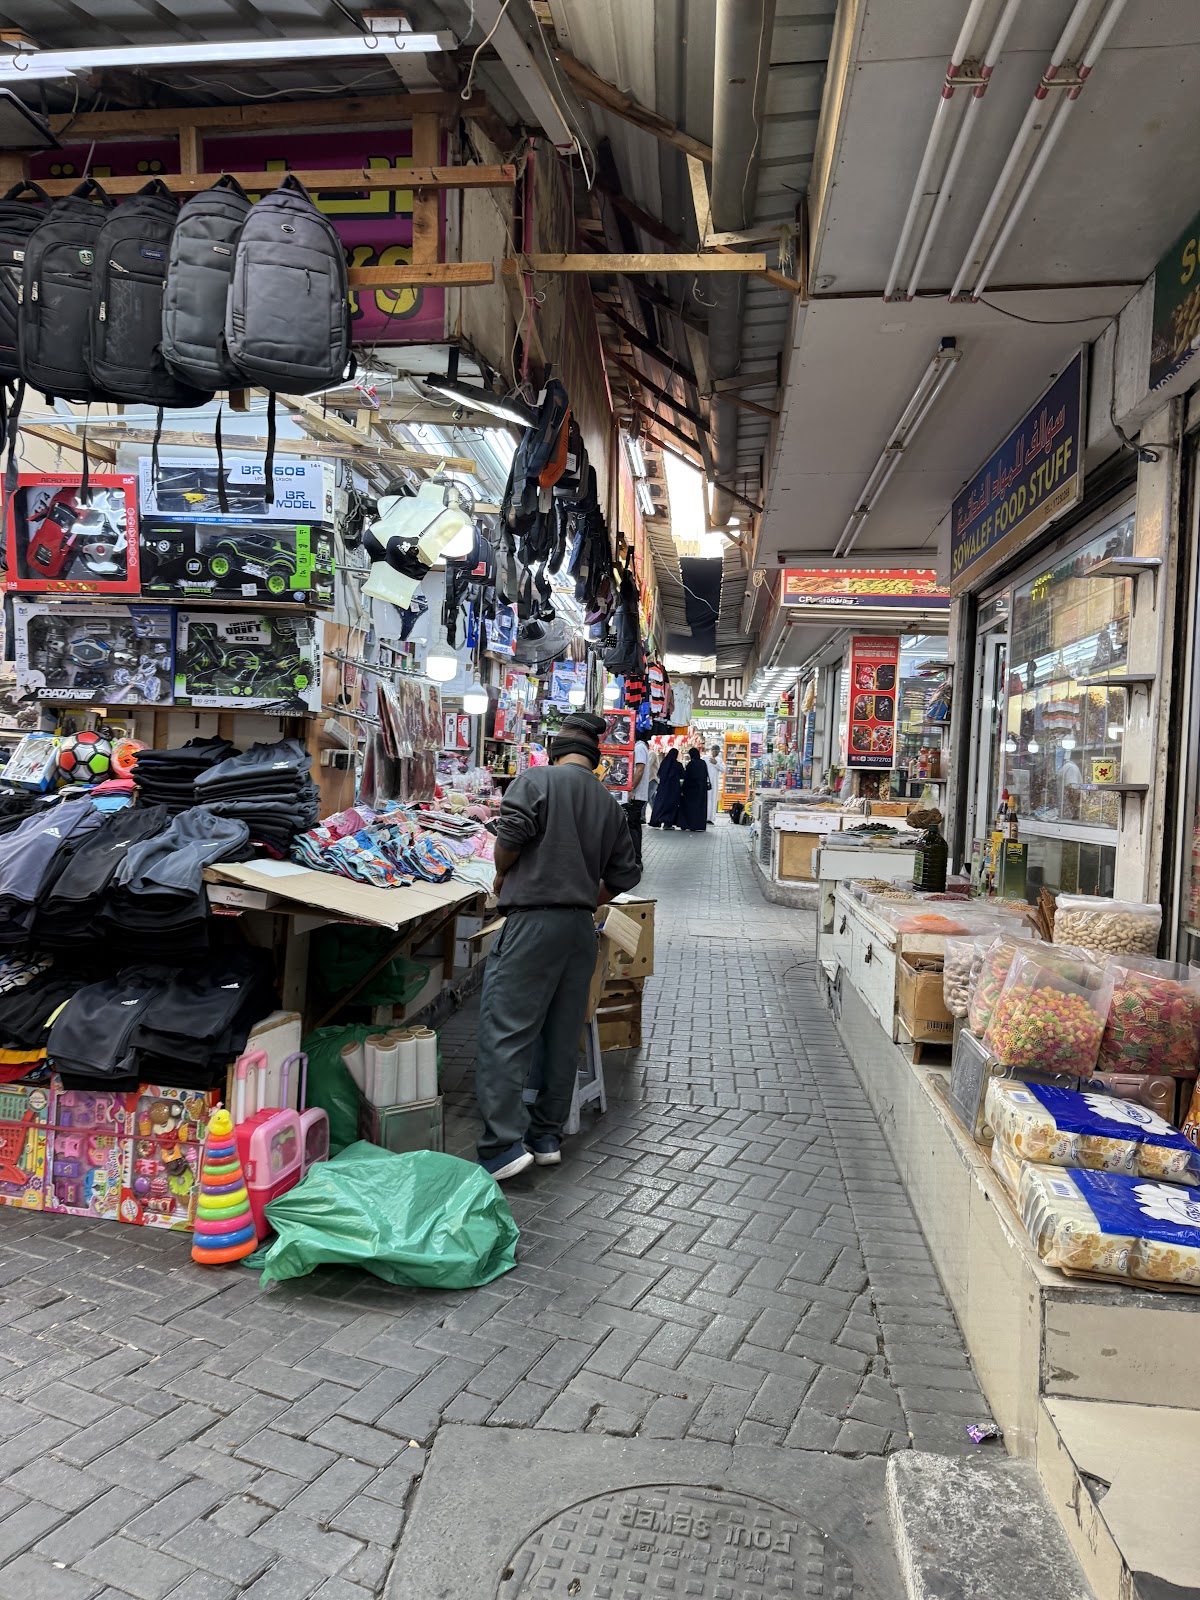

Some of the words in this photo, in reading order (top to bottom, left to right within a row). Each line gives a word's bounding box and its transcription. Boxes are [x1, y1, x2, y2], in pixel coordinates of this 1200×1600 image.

[276, 500, 316, 509] MODEL
[285, 491, 305, 500] BR
[953, 515, 992, 575] SOWALEF
[994, 485, 1027, 537] FOOD
[1029, 435, 1073, 506] STUFF
[697, 677, 720, 699] AL
[700, 699, 727, 707] CORNER
[618, 1505, 711, 1540] SEWER
[719, 1521, 792, 1554] FOUL
